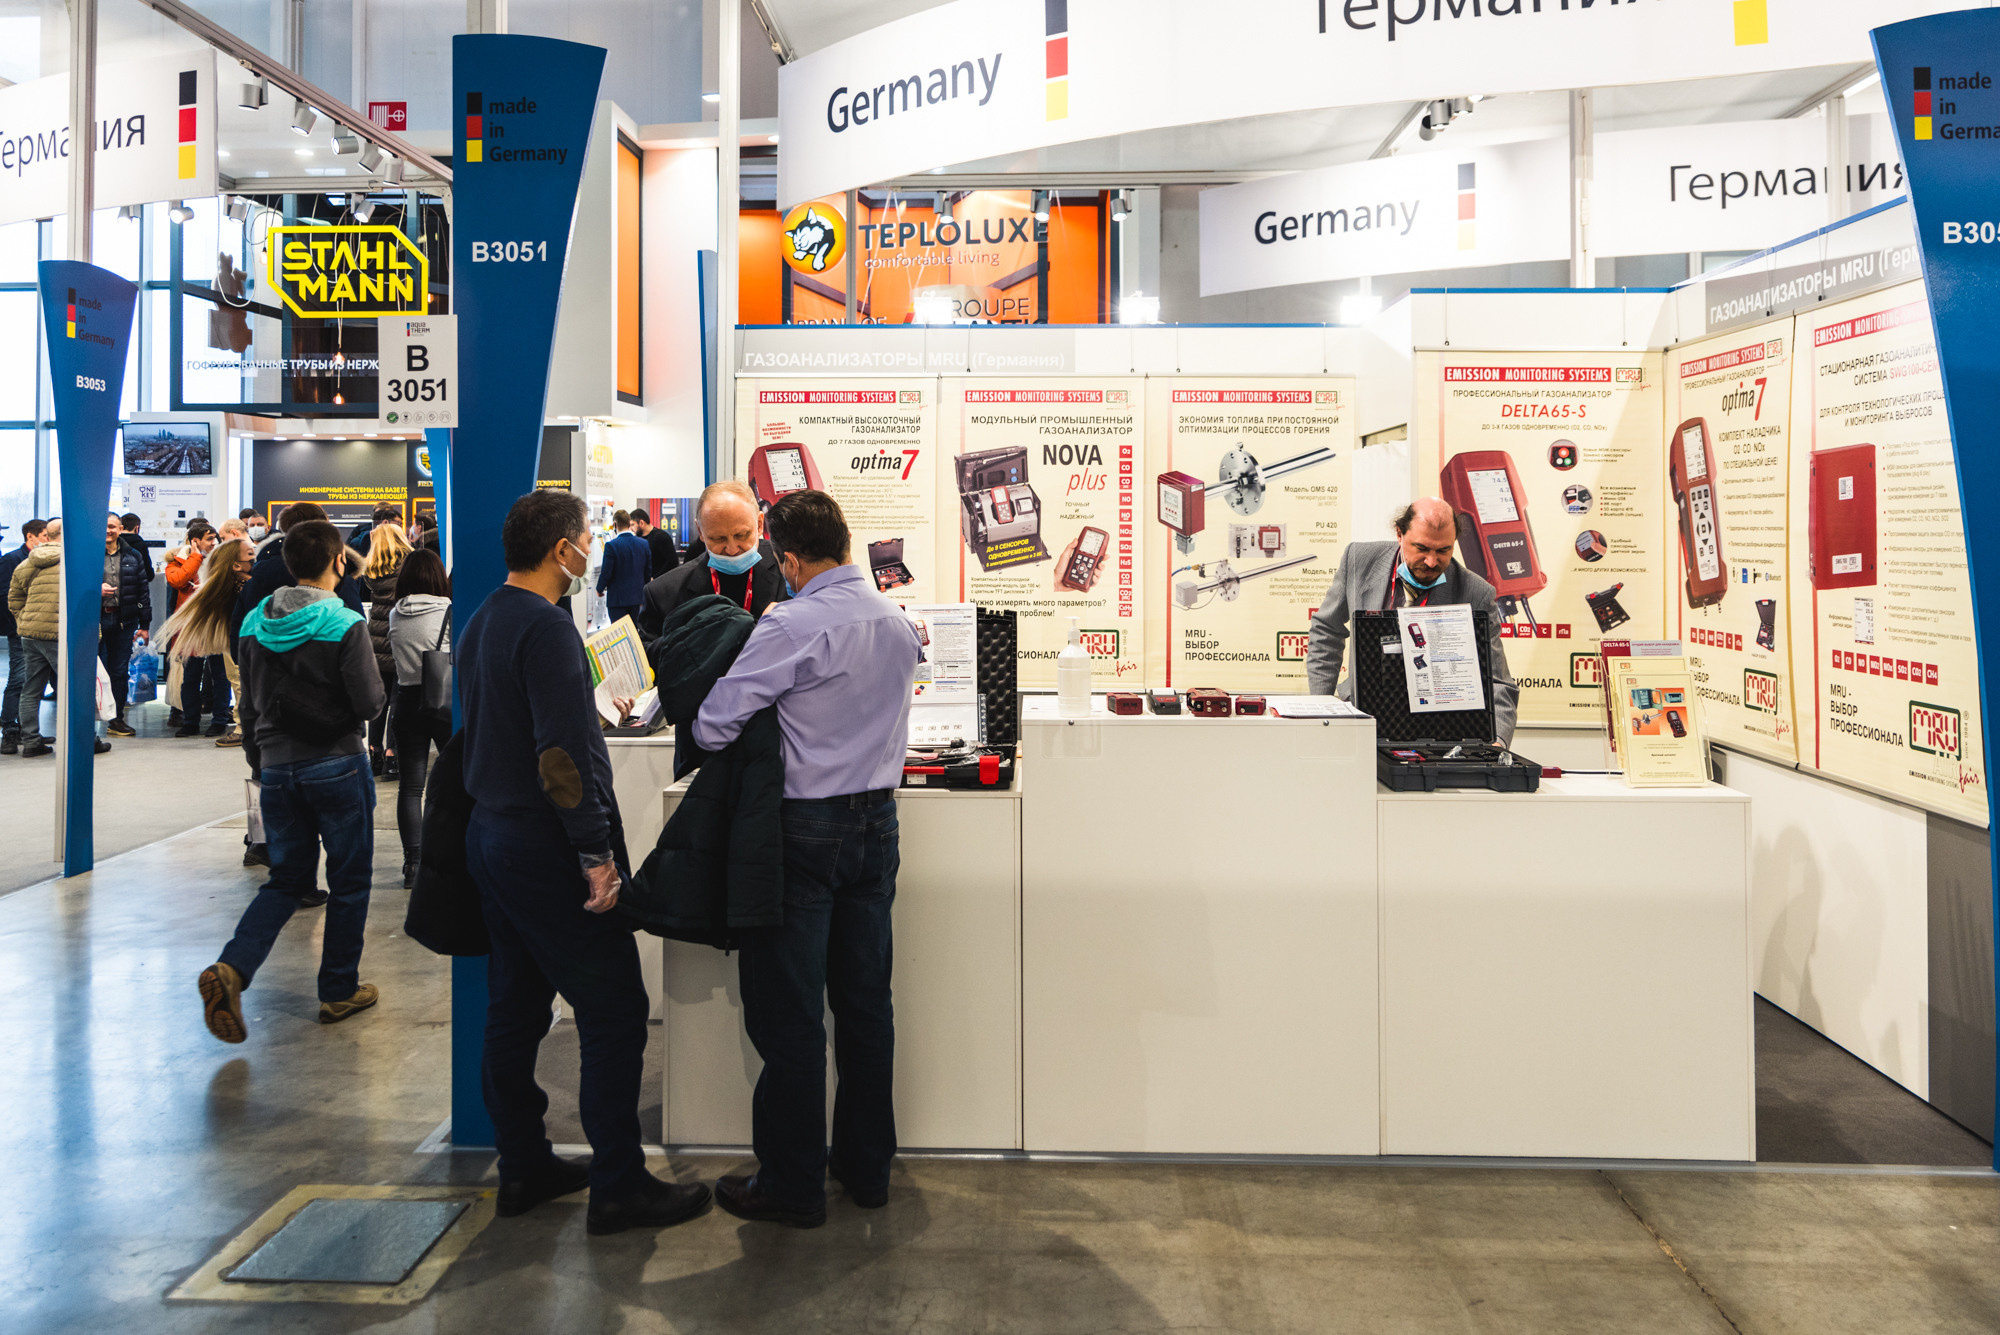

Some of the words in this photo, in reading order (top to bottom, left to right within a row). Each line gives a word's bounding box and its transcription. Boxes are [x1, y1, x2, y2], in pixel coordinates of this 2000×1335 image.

[1939, 72, 1992, 90] made
[826, 51, 1003, 134] Germany
[489, 97, 537, 114] made
[1939, 98, 1956, 115] in
[489, 122, 504, 138] in
[490, 146, 568, 165] Germany
[1255, 199, 1420, 245] Germany
[858, 217, 1048, 250] TEPLOLUXE
[281, 241, 414, 271] STAHL
[472, 241, 547, 262] B3051
[864, 252, 955, 269] comfortable
[958, 251, 1000, 266] living
[282, 272, 414, 302] MANN
[1710, 271, 1837, 325] ГАЗОАНАЛИЗАТОРЫ
[1840, 260, 1874, 284] MRU
[79, 297, 102, 311] made
[79, 312, 86, 323] in
[78, 329, 116, 350] Germany
[1816, 322, 1852, 345] EMISSION
[187, 359, 288, 371] ГОФРИРОВАННЫЕ
[289, 359, 328, 370] ТРУБЫ
[407, 345, 429, 372] B
[745, 352, 923, 367] ГАЗОАНАЛИЗАТОРЫ
[929, 353, 969, 367] MRU
[972, 352, 1065, 370] (Германия)
[1681, 361, 1707, 377] EMISSION
[1708, 352, 1740, 372] MONITORING
[1741, 345, 1764, 362] SYSTEMS
[1820, 355, 1875, 377] СТАЦИОНАРНАЯ
[1446, 368, 1500, 381] EMISSION
[1505, 369, 1565, 381] MONITORING
[1569, 369, 1609, 381] SYSTEMS
[1853, 370, 1888, 386] СИСТЕМА
[76, 375, 106, 392] B3053
[387, 378, 447, 402] 3051
[761, 392, 805, 403] EMISSION
[809, 392, 858, 403] MONITORING
[861, 392, 894, 403] SYSTEMS
[967, 391, 1011, 402] EMISSION
[1015, 391, 1064, 402] MONITORING
[1068, 391, 1101, 402] SYSTEMS
[1174, 391, 1219, 402] EMISSION
[1223, 391, 1273, 402] MONITORING
[1276, 392, 1310, 402] SYSTEMS
[1453, 389, 1539, 398] ПРОФЕССИОНАЛЬНЫЙ
[1820, 407, 1831, 418] ДЛЯ
[1831, 403, 1861, 416] КОНТРОЛЯ
[1861, 393, 1922, 412] ТЕХНОЛОГИЧЕСКИХ
[799, 415, 853, 424] КОМПАКТНЫЙ
[855, 415, 921, 424] ВЫСОКОТОЧНЫЙ
[971, 414, 1037, 425] МОДУЛЬНЫЙ
[1040, 414, 1133, 424] ПРОМЫШЛЕННЫЙ
[1179, 416, 1224, 424] ЭКОНОМИЯ
[1227, 416, 1264, 424] ТОПЛИВА
[1267, 416, 1283, 424] ПРИ
[1285, 416, 1339, 424] ПОСТОЯННОЙ
[1845, 419, 1849, 427] И
[1850, 410, 1894, 426] МОНИТОРИНГА
[1895, 406, 1932, 420] ВЫБРОСОВ
[851, 426, 921, 434] ГАЗОАНАЛИЗАТОР
[1039, 427, 1133, 435] ГАЗОАНАЛИЗАТОР
[1178, 426, 1239, 434] ОПТИМИЗАЦИИ
[1242, 426, 1290, 434] ПРОЦЕССОВ
[1294, 426, 1330, 434] ГОРЕНИЯ
[1043, 444, 1103, 465] NOVA
[1066, 468, 1107, 496] plus
[299, 486, 343, 494] ИНЖЕНЕРНЫЕ
[343, 486, 374, 494] СИСТЕМЫ
[375, 486, 384, 494] НА
[384, 486, 400, 494] БАЗЕ
[358, 492, 408, 500] НЕРЖАВЕЮЩЕЙ
[999, 539, 1029, 550] СЕНСОРОВ
[988, 545, 1035, 560] ОДНОВРЕМЕННО!
[969, 598, 994, 607] Нужно
[995, 600, 1031, 608] измерять
[1057, 600, 1107, 608] параметров?
[1185, 629, 1207, 638] MRU
[1185, 641, 1220, 649] ВЫБОР
[1185, 652, 1271, 662] ПРОФЕССИОНАЛА
[1690, 656, 1703, 668] MRU
[1834, 655, 1840, 663] O2
[1845, 656, 1852, 665] CO
[1858, 658, 1865, 667] NO
[1116, 661, 1138, 677] fair
[1870, 660, 1880, 670] NO2
[1883, 662, 1893, 672] NOx
[1897, 665, 1908, 674] SO2
[1912, 667, 1921, 677] CO2
[1927, 669, 1938, 679] CH4
[1746, 674, 1776, 708] MRU
[1830, 683, 1847, 698] MRU
[1830, 700, 1858, 717] ВЫБОР
[1775, 718, 1790, 741] fair
[1830, 718, 1904, 747] ПРОФЕССИОНАЛА
[1913, 708, 1957, 752] MRU
[1908, 769, 1927, 780] EMISSION
[1959, 764, 1980, 793] fair
